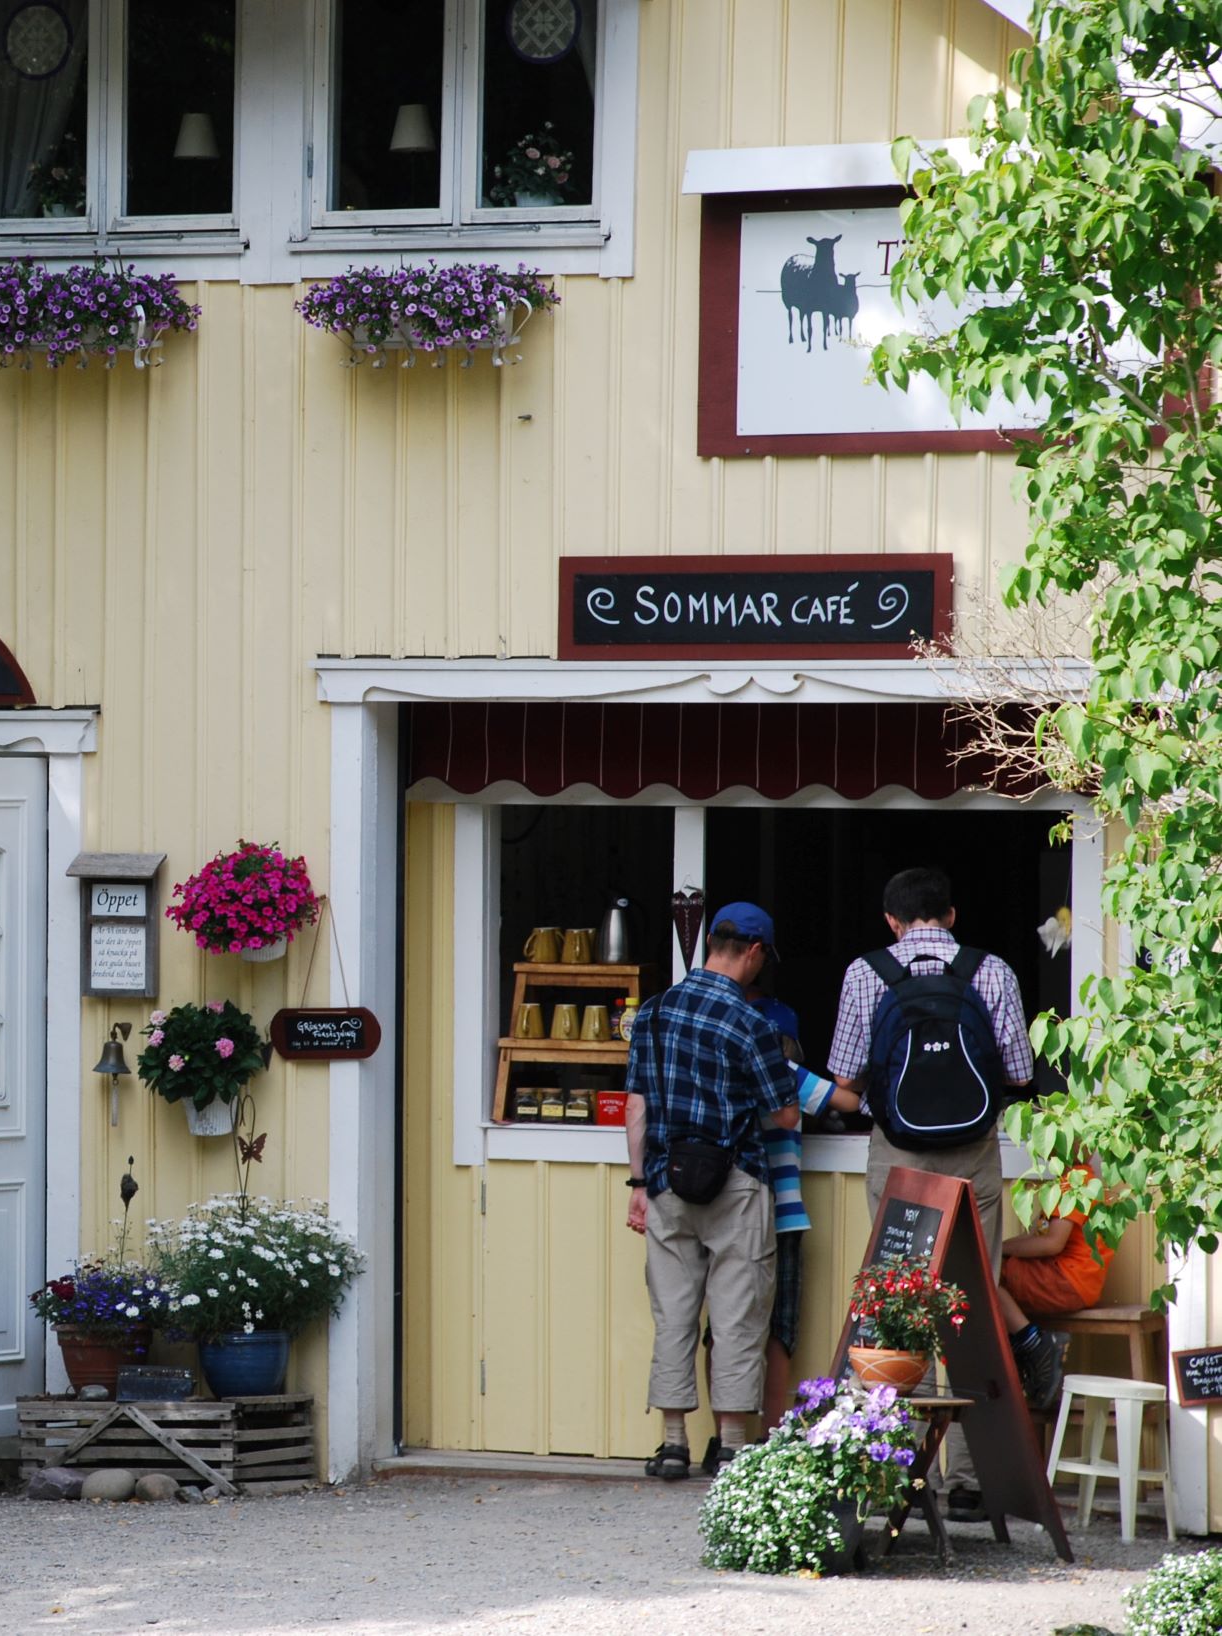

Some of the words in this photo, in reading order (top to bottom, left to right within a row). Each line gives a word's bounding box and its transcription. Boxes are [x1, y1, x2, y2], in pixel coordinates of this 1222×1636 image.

[634, 585, 782, 627] SOMMAR
[791, 581, 860, 625] CAFÉ
[97, 888, 138, 912] Öppet
[1204, 1365, 1222, 1375] ÖPPE
